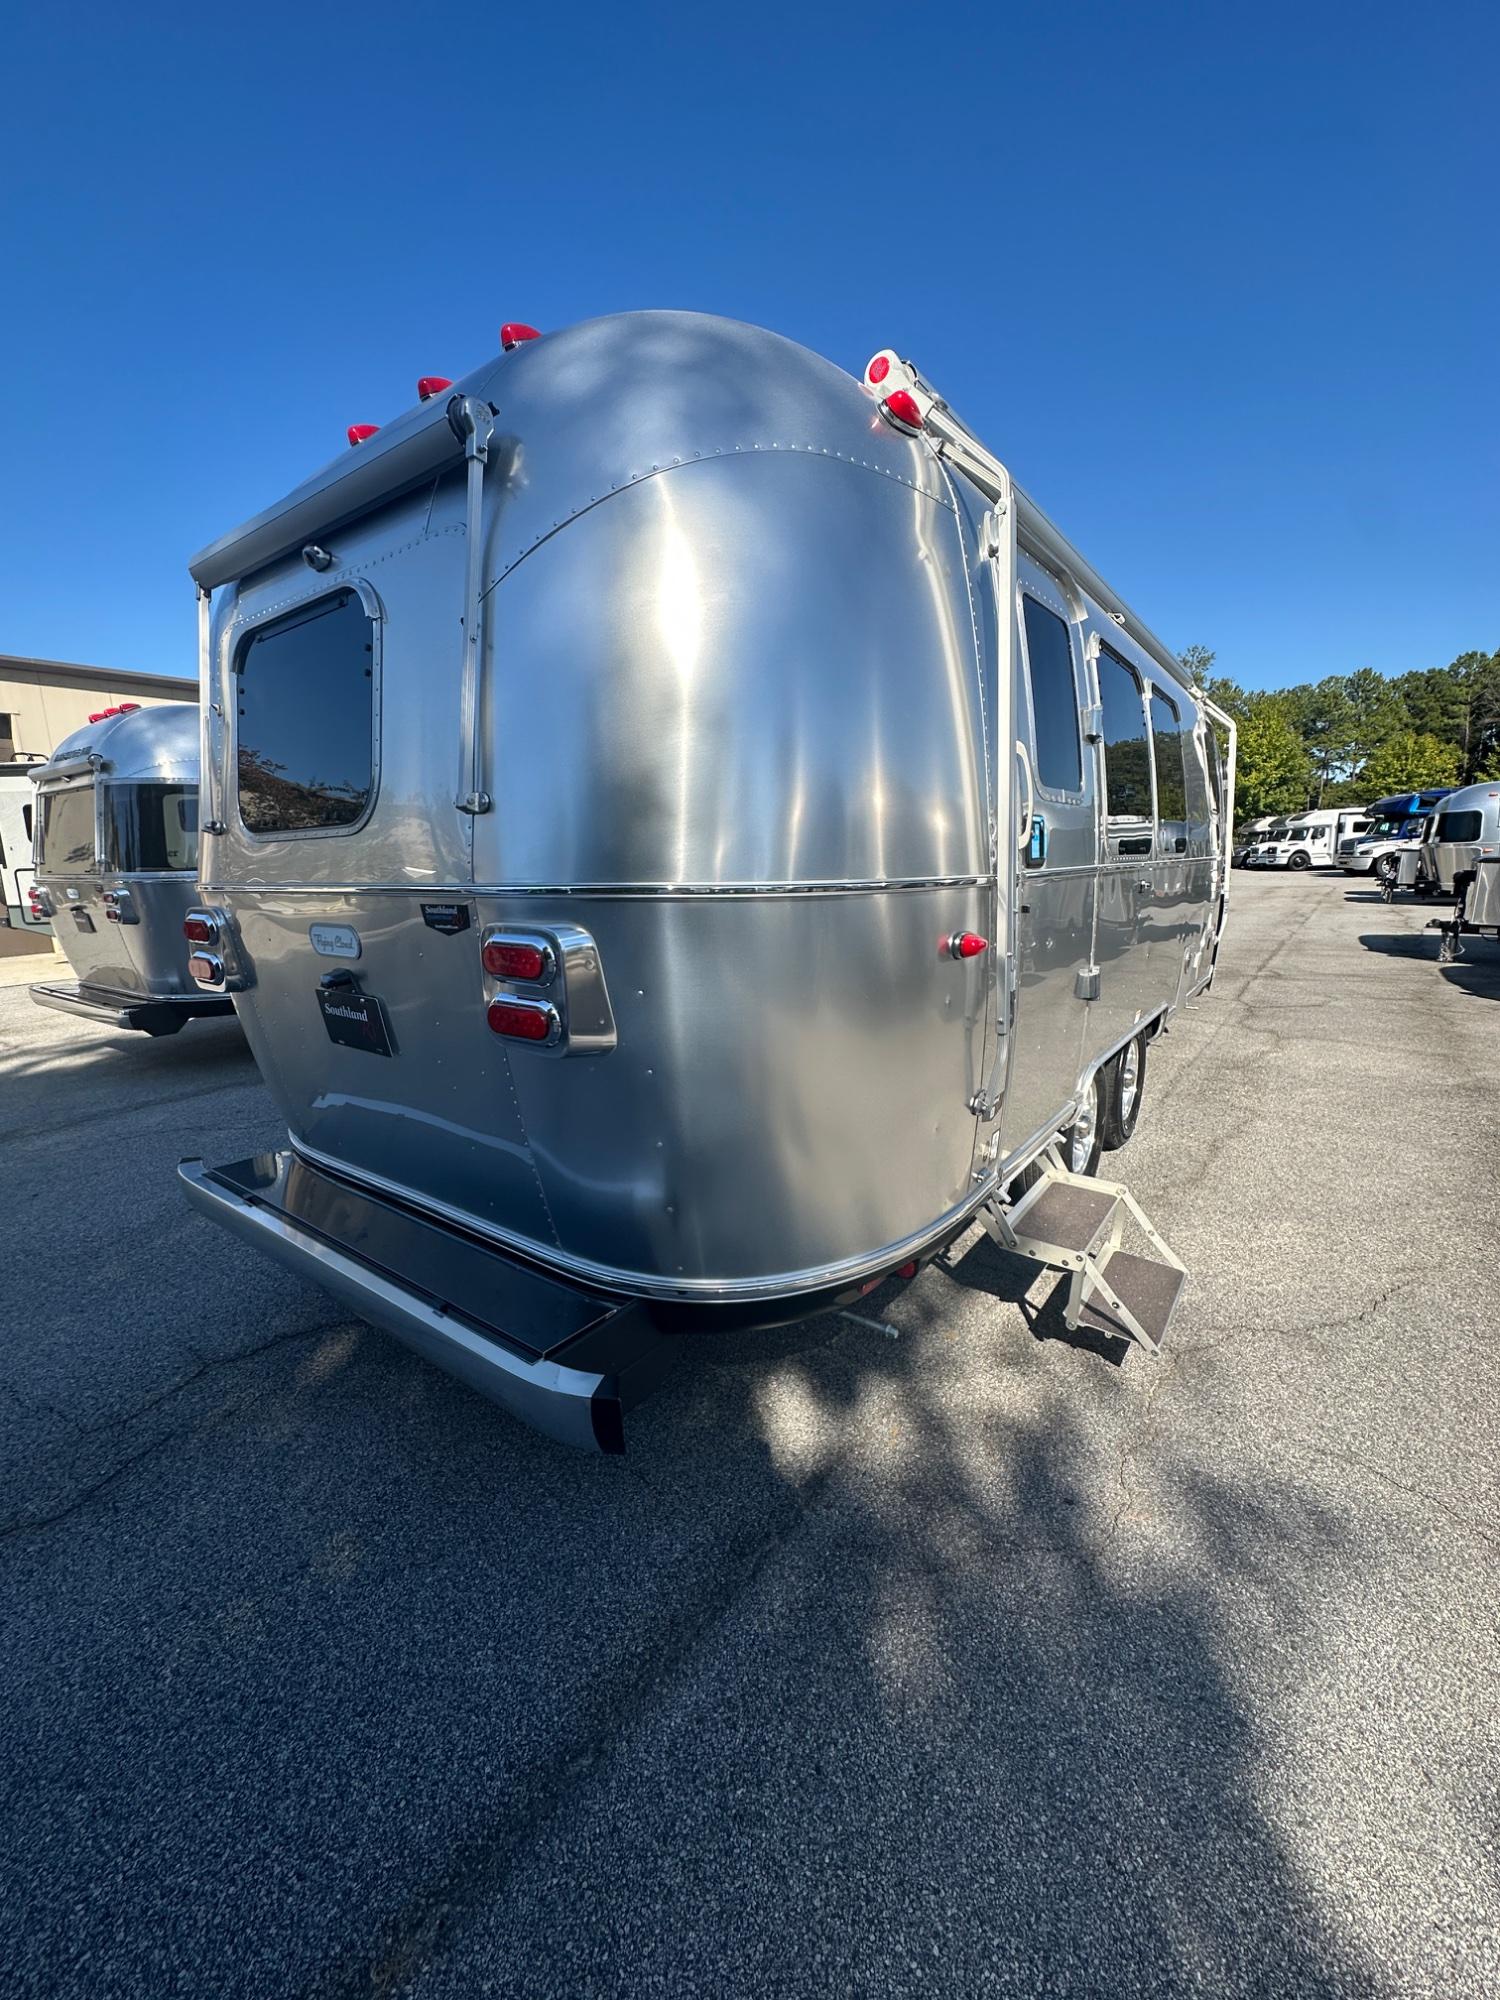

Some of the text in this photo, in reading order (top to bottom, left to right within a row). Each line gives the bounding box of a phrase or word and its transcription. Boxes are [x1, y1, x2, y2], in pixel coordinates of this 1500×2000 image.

[424, 904, 458, 915] Southland
[313, 933, 353, 952] Flying Cloud
[324, 1003, 369, 1022] Southland
